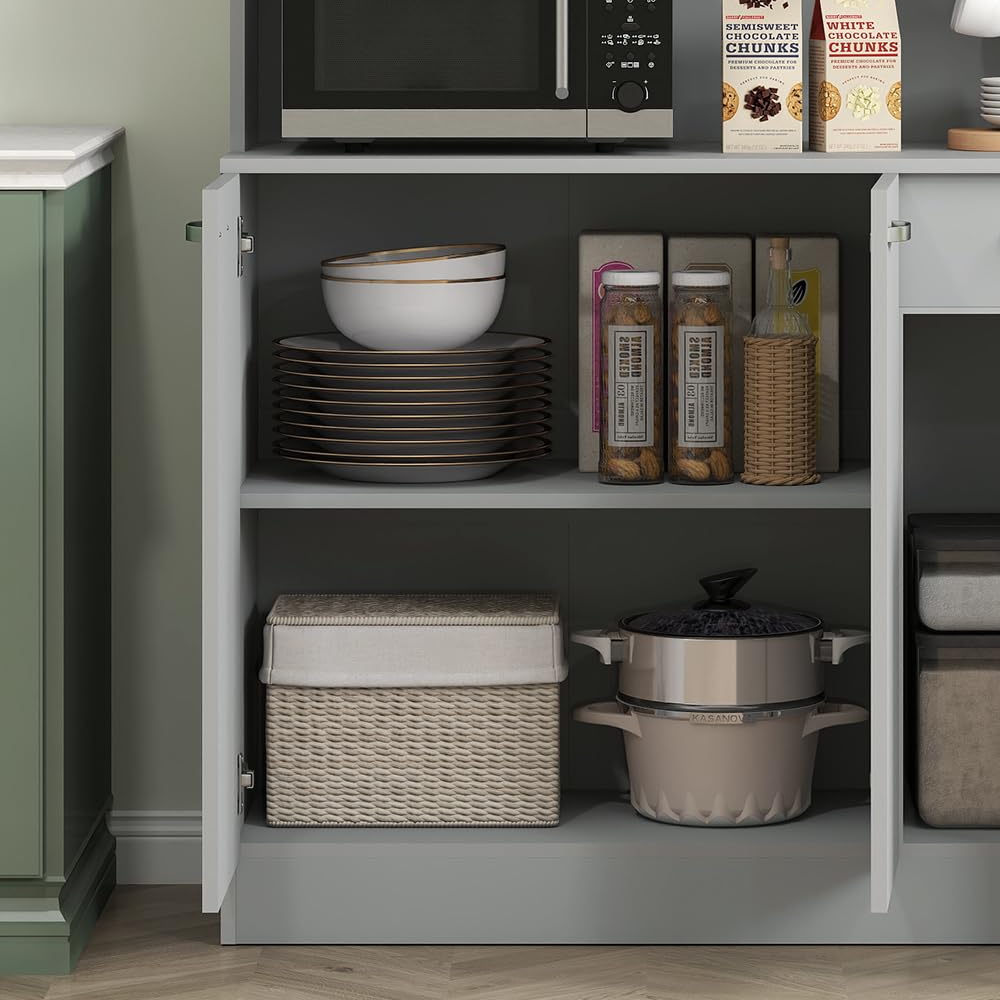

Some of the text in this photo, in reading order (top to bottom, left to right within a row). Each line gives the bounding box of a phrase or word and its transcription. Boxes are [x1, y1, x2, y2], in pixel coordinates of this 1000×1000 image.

[726, 23, 799, 31] SEMISWEET
[827, 22, 875, 30] WHITE
[828, 32, 898, 40] CHOCOLATE
[726, 42, 799, 54] CHUNKS
[829, 42, 898, 53] CHUNKS
